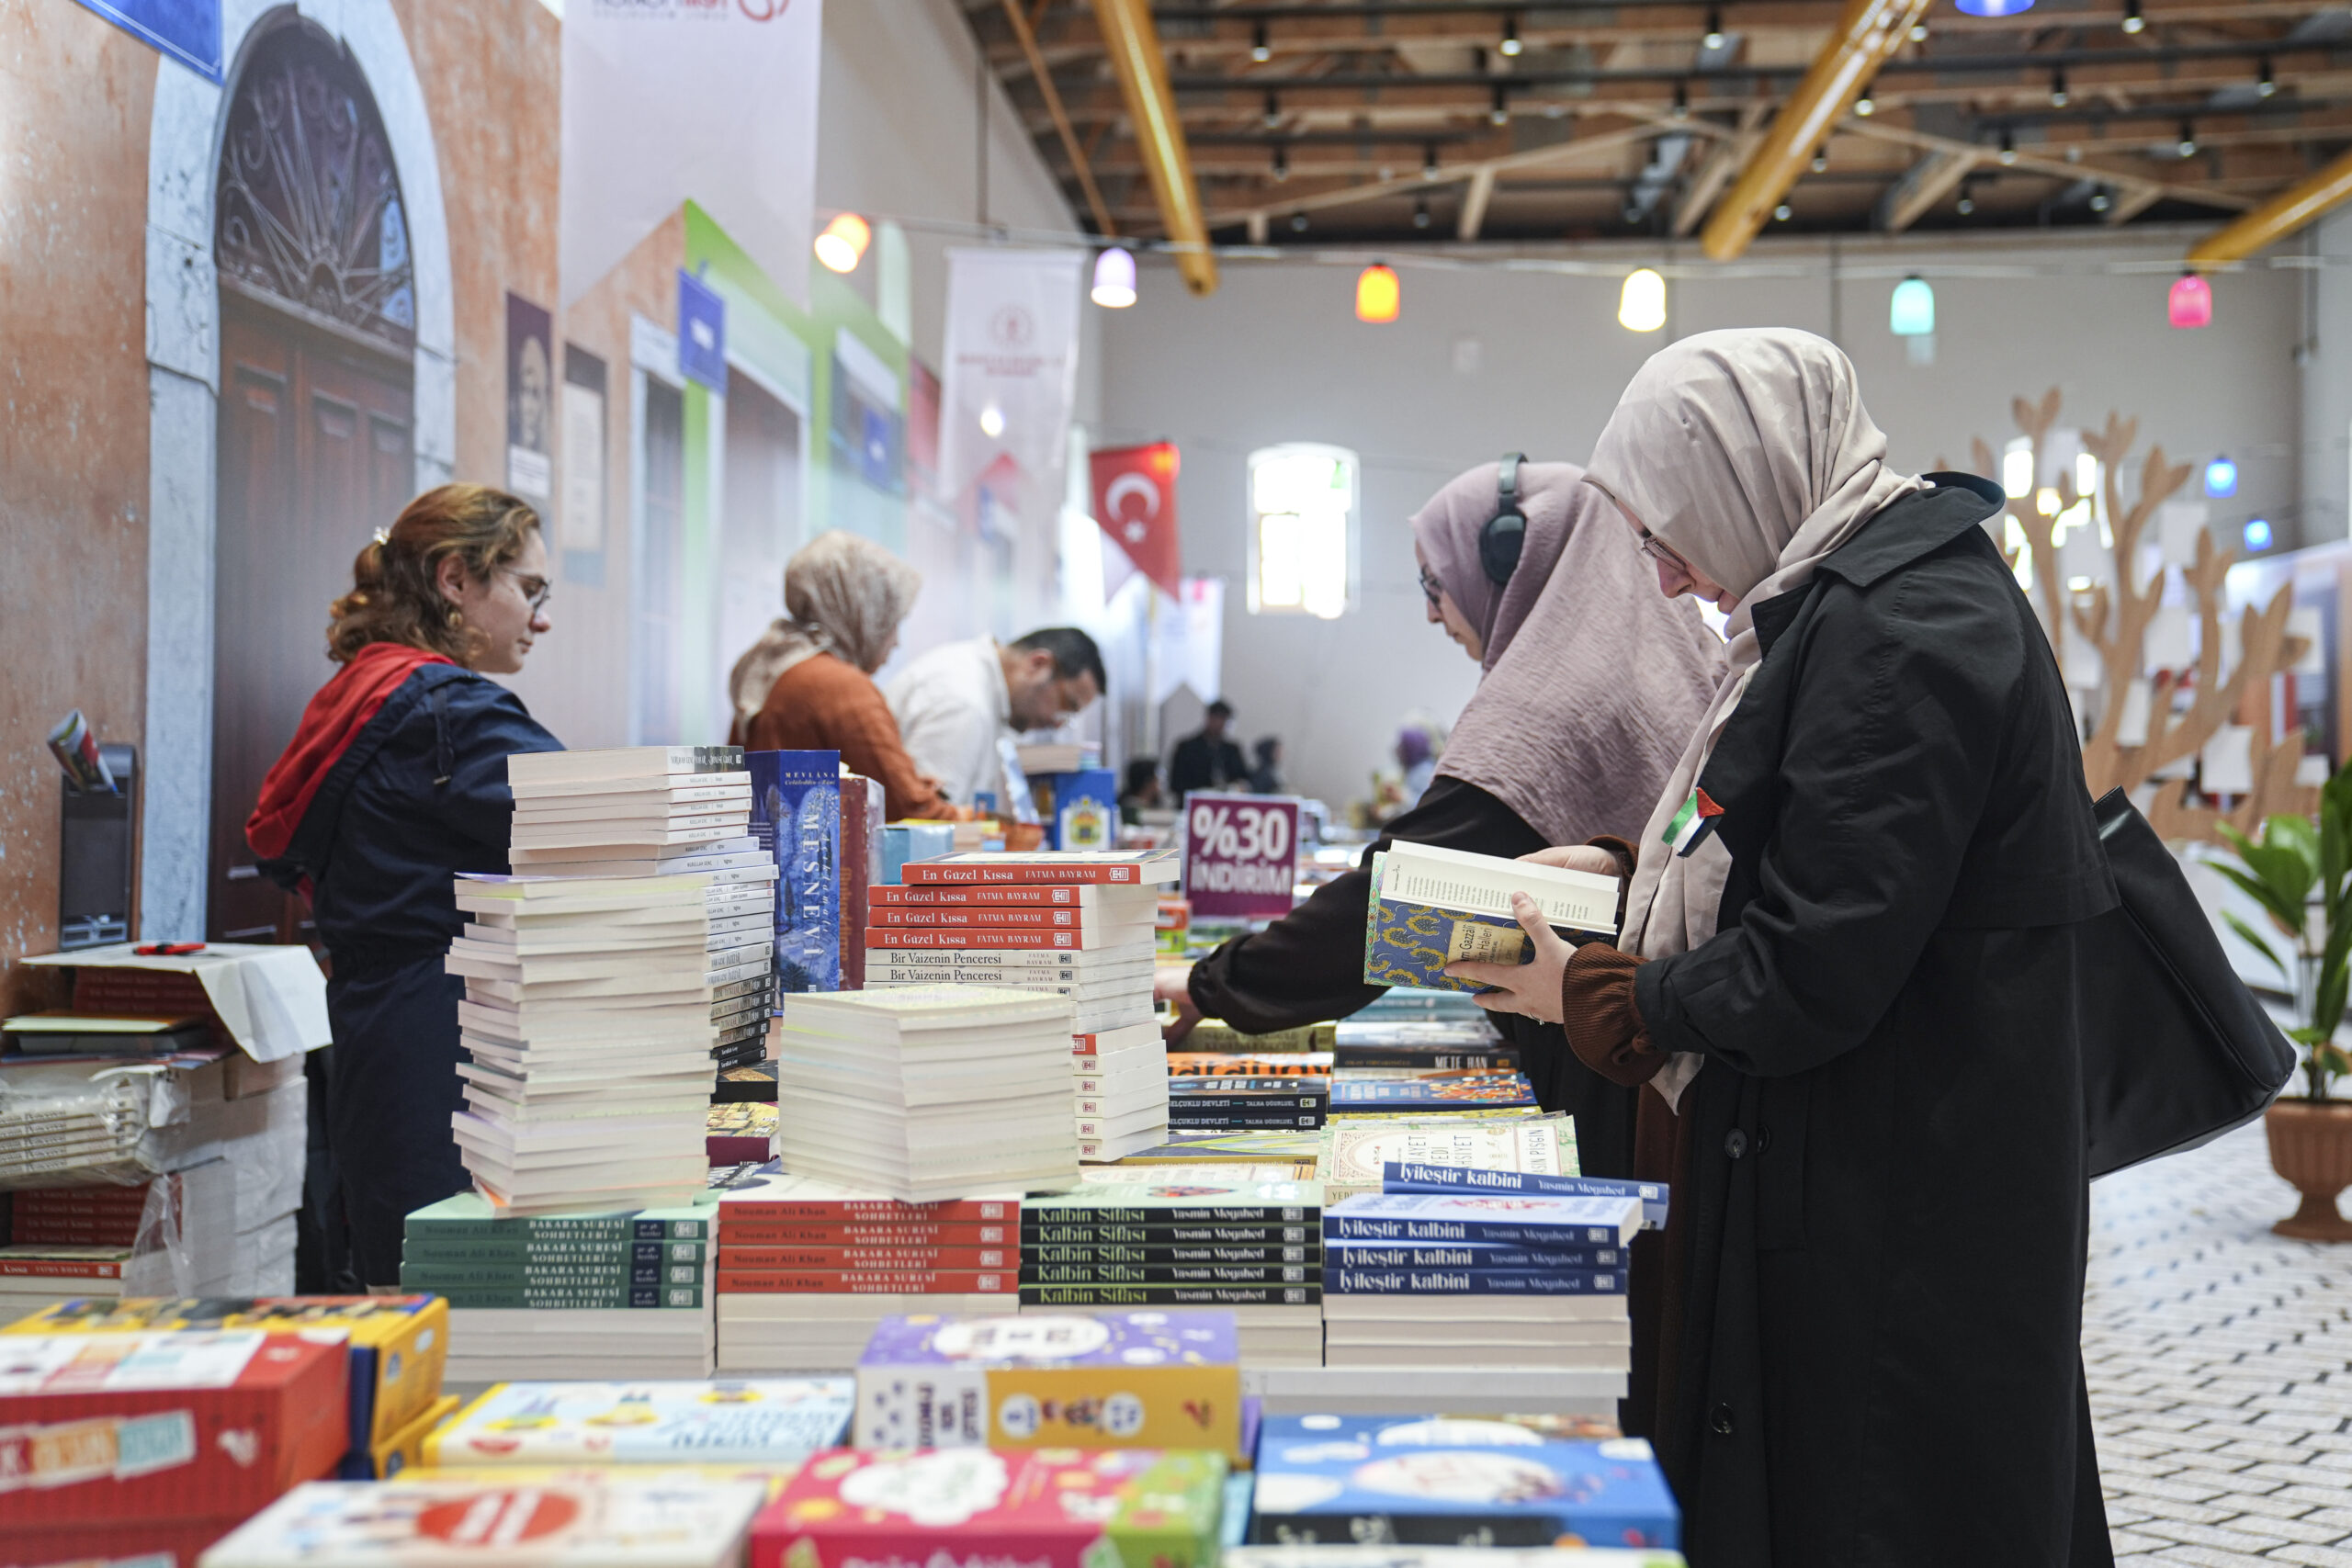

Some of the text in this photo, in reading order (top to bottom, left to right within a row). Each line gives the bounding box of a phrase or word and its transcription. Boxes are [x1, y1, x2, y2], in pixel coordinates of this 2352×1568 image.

[1193, 806, 1290, 861] %30
[922, 870, 937, 880] En
[983, 870, 1013, 880] Kıssa
[1025, 870, 1096, 878] FATMA BAYRAM
[1191, 854, 1292, 895] İNDİRİM
[803, 814, 824, 955] MESNEVÎ
[887, 892, 899, 902] En
[940, 892, 967, 902] Kıssa
[977, 892, 1040, 900] FATMA BAYRAM
[888, 913, 900, 923] En
[941, 913, 967, 923] Kıssa
[978, 914, 1041, 922] FATMA BAYRAM
[885, 934, 898, 944] En
[939, 934, 967, 944] Kıssa
[977, 935, 1041, 943] FATMA BAYRAM
[890, 953, 1001, 964] Bir Vaizenin Penceresi
[890, 970, 1002, 980] Bir Vaizenin Penceresi
[1435, 1056, 1487, 1069] METE HAN
[1202, 1099, 1230, 1107] DEVLETİ
[1170, 1118, 1200, 1126] ELÇUKLU
[1400, 1163, 1522, 1189] İyileştir kalbini
[1538, 1179, 1625, 1196] Yasmin Mogahed
[844, 1201, 892, 1210] BAKARA
[798, 1207, 826, 1215] Khan
[855, 1212, 927, 1220] SOHBETLERİ
[1038, 1208, 1091, 1223] Kalbin
[1172, 1209, 1264, 1222] Yasmin Mogahed
[529, 1220, 578, 1229] BAKARA
[1340, 1217, 1465, 1238] İyileştir kalbini
[799, 1231, 826, 1239] Khan
[1039, 1226, 1092, 1242] Kalbin
[1173, 1228, 1265, 1242] Yasmin Mogahed
[1482, 1227, 1521, 1239] Yasmin
[526, 1244, 575, 1252] BAKARA
[798, 1255, 825, 1263] Khan
[1038, 1246, 1091, 1262] Kalbin
[1172, 1248, 1264, 1262] Yasmin Mogahed
[1343, 1247, 1472, 1269] İyileştir kalbini
[1490, 1252, 1528, 1264] Yasmin
[854, 1259, 926, 1268] SOHBETLERİ
[526, 1266, 574, 1274] BAKARA
[1038, 1265, 1091, 1281] Kalbin
[1172, 1269, 1264, 1281] Yasmin Mogahed
[842, 1273, 890, 1281] BAKARA
[1340, 1269, 1470, 1292] İyileştir kalbini
[797, 1279, 823, 1287] Khan
[852, 1283, 924, 1292] SOHBETLERİ
[1487, 1277, 1525, 1288] Yasmin
[525, 1289, 573, 1297] BAKARA
[1040, 1288, 1093, 1303] Kalbin
[1174, 1290, 1266, 1303] Yasmin Mogahed
